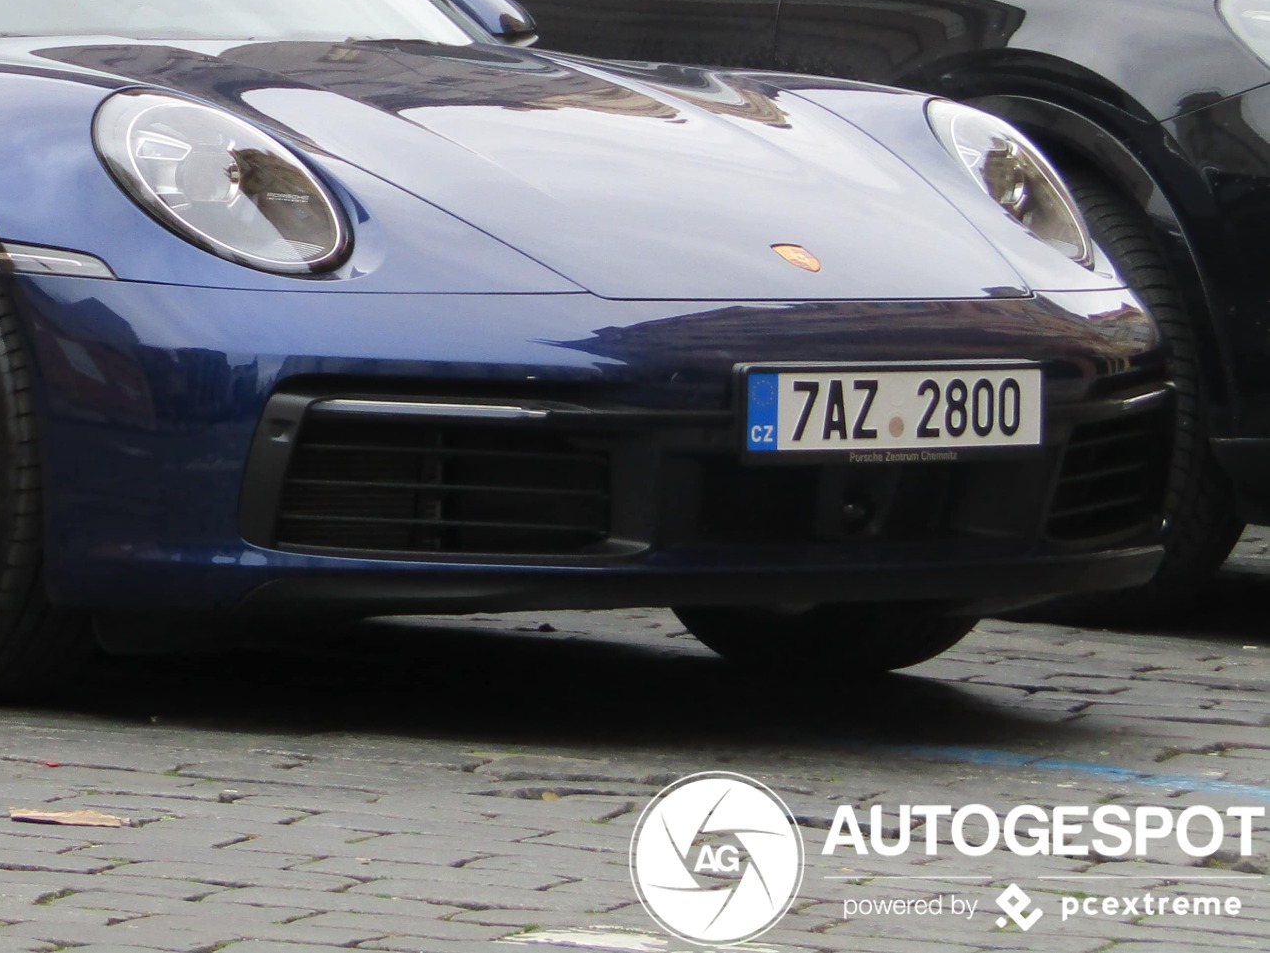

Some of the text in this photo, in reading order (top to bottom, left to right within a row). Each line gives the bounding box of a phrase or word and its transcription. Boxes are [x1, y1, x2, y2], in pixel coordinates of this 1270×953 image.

[792, 378, 1021, 441] 7AZ 2800
[751, 425, 774, 443] CZ
[849, 450, 957, 463] Porsche Zentrum Chemnitz
